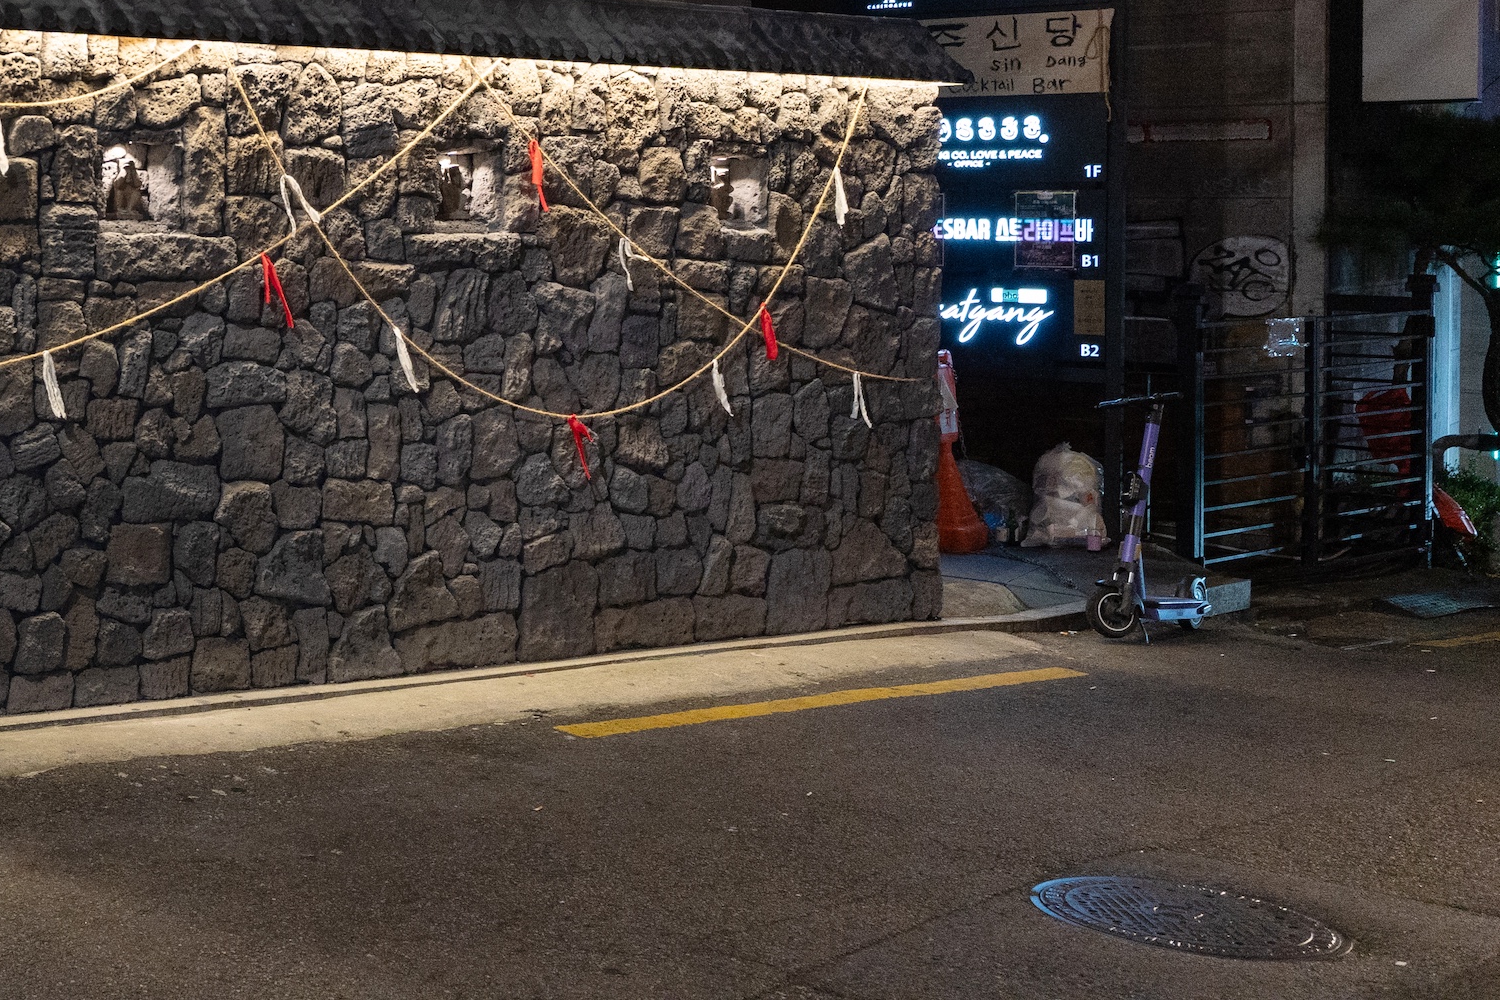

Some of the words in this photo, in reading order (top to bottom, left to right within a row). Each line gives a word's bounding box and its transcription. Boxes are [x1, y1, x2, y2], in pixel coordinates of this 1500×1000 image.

[1033, 78, 1071, 93] Bar
[970, 150, 997, 160] LOVE
[1008, 150, 1042, 159] PEACE
[1084, 165, 1101, 178] 1F
[932, 218, 990, 240] ESBAR
[1081, 255, 1098, 267] B1
[939, 288, 1054, 345] atgang
[1081, 344, 1099, 357] B2
[1145, 447, 1156, 469] beam
